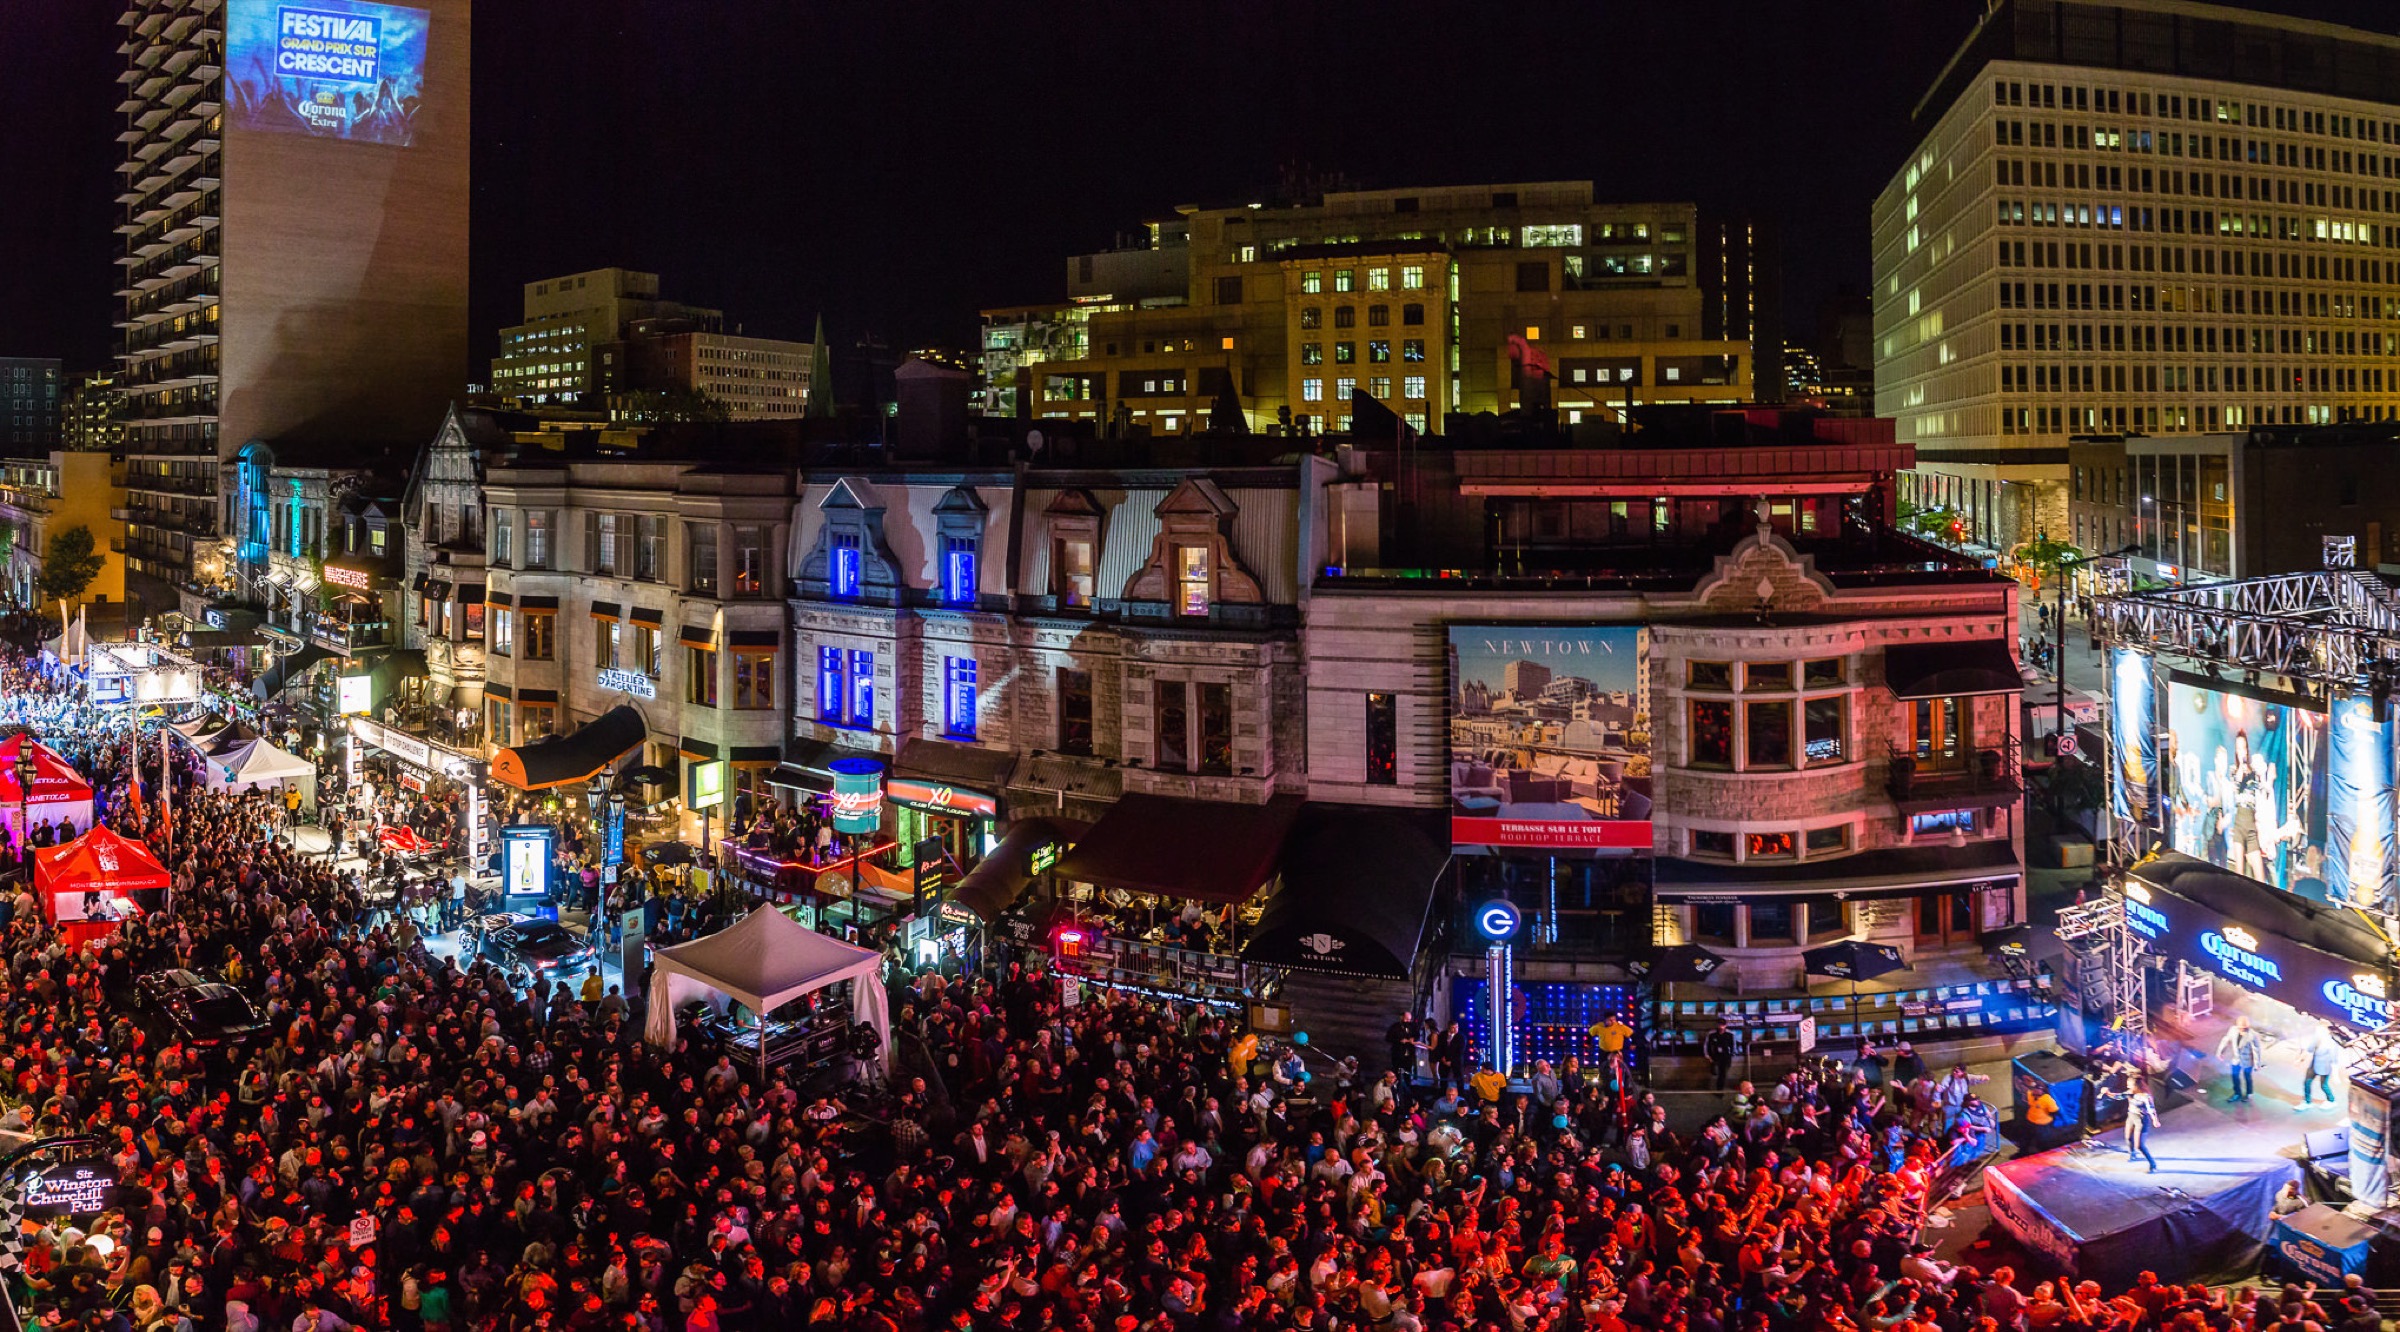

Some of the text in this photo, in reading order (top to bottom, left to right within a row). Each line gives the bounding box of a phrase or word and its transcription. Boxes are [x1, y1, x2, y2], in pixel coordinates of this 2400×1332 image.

[282, 12, 377, 43] FESTIVAL
[281, 36, 376, 58] GRAND PRIX SUR
[279, 51, 376, 78] CRESCENT
[298, 100, 346, 118] Corona
[311, 115, 337, 127] Extra
[1484, 640, 1613, 655] NEWTOWN
[605, 669, 645, 685] L'ATELIER
[598, 676, 652, 697] D'ARGENTINE
[837, 792, 860, 809] XO
[928, 787, 953, 809] XO
[1501, 824, 1545, 833] TERRASSE
[1548, 825, 1566, 833] SUR
[1582, 826, 1602, 834] TOIT
[1500, 833, 1601, 843] ROOFTOP TERRACE
[100, 860, 119, 871] 96
[1008, 919, 1035, 931] Ziggy's
[1302, 953, 1343, 962] NEWTOWN
[2201, 932, 2282, 981] Corona
[2222, 957, 2265, 987] Extra
[2351, 1007, 2386, 1030] Ext
[76, 1170, 94, 1179] Sir
[44, 1178, 113, 1192] Winston
[27, 1187, 103, 1206] Churchill
[70, 1200, 103, 1213] Pub
[2280, 1241, 2341, 1278] Corona
